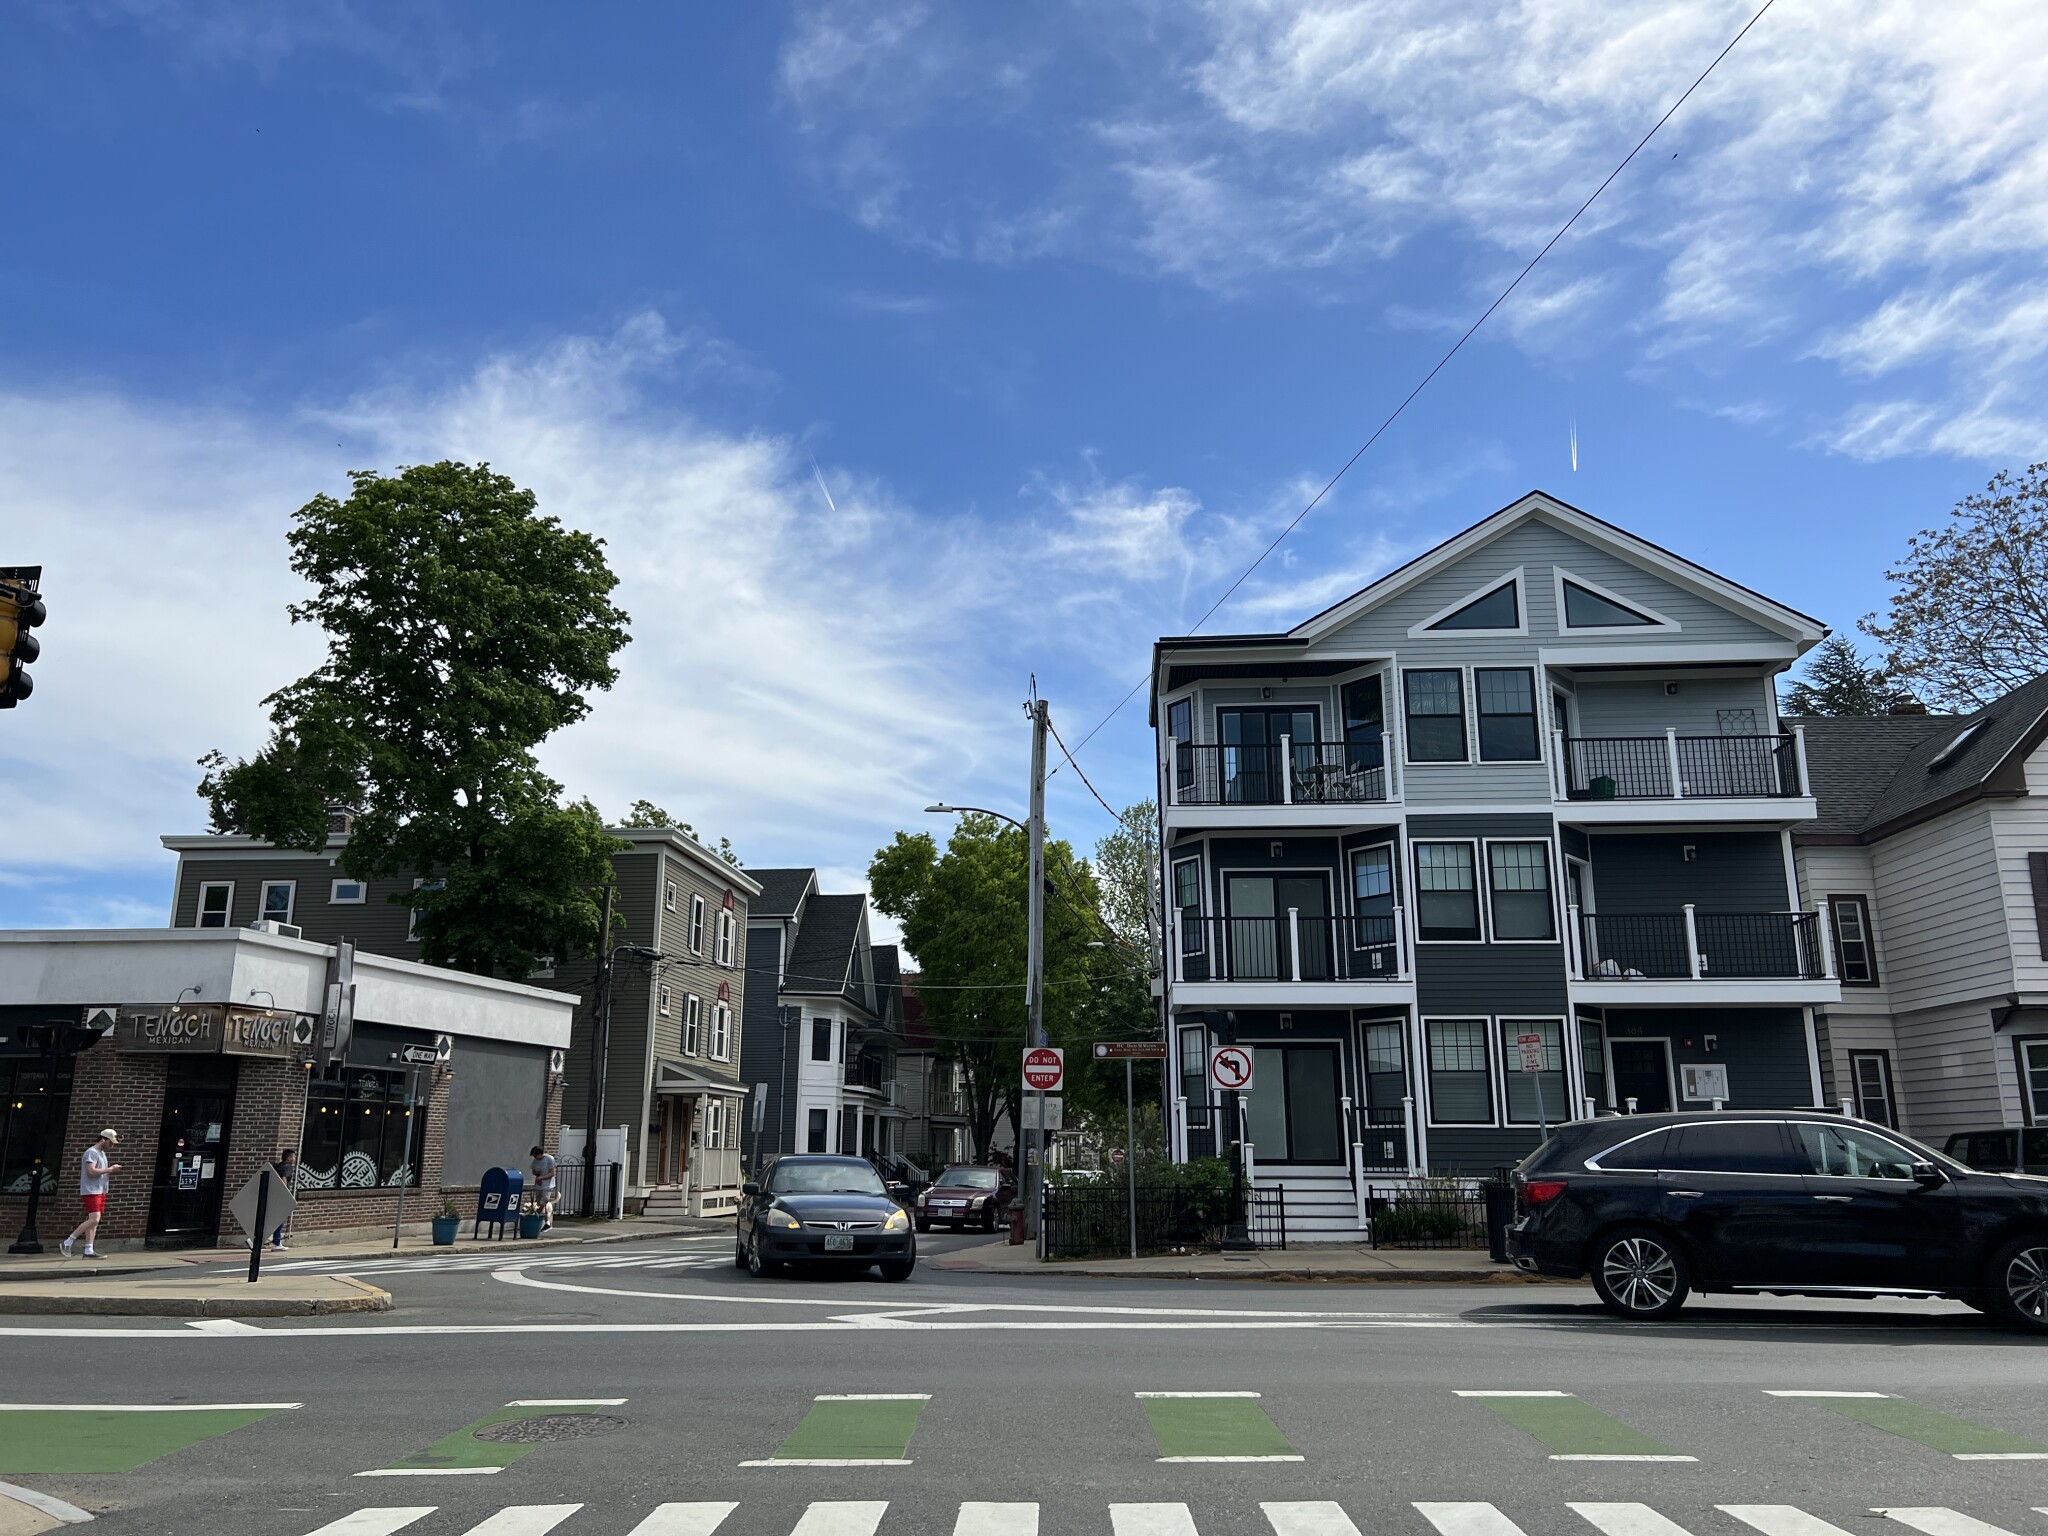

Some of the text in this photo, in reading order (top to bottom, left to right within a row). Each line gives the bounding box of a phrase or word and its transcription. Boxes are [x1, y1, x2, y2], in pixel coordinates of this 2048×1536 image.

[243, 1040, 275, 1048] MEXICAN
[424, 1052, 434, 1060] WAY
[1031, 1074, 1054, 1082] ENTER
